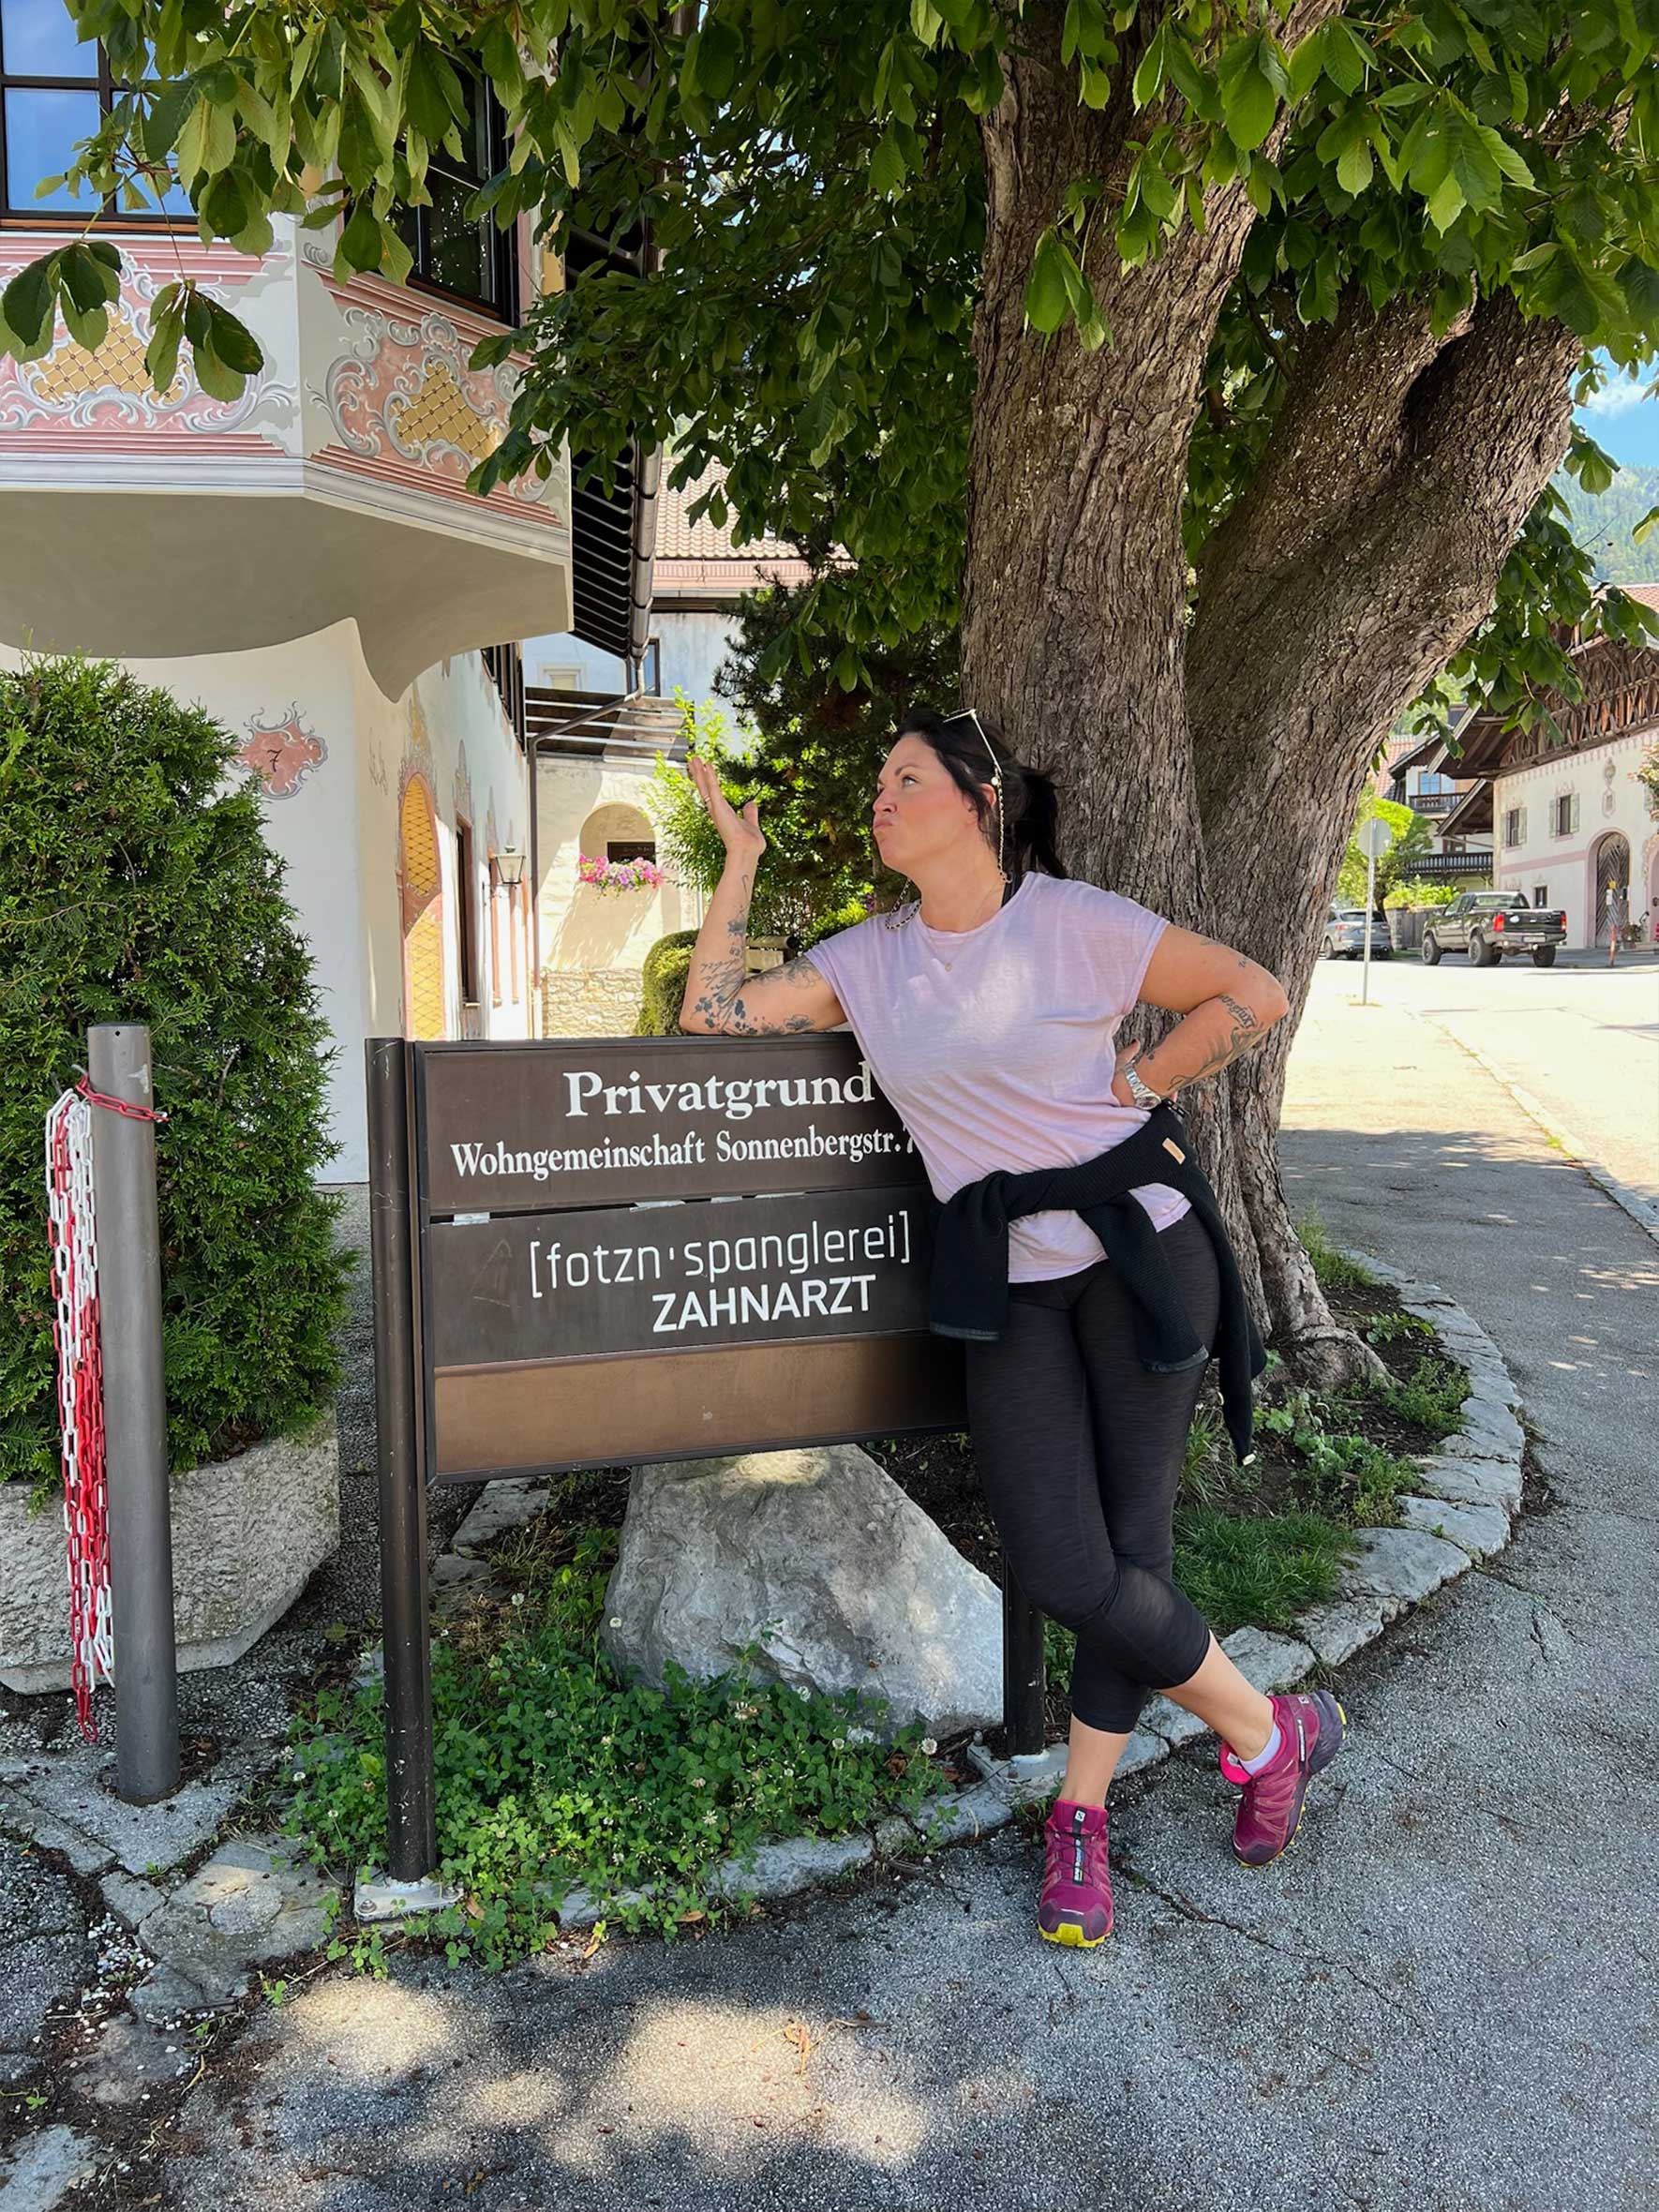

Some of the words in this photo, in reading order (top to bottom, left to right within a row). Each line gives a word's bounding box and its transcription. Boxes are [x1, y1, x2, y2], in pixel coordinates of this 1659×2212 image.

[267, 749, 282, 772] 7
[562, 1061, 876, 1120] Privatgrund
[449, 1130, 706, 1181] Wohngemeinschaft
[651, 1274, 876, 1333] ZAHNARZT
